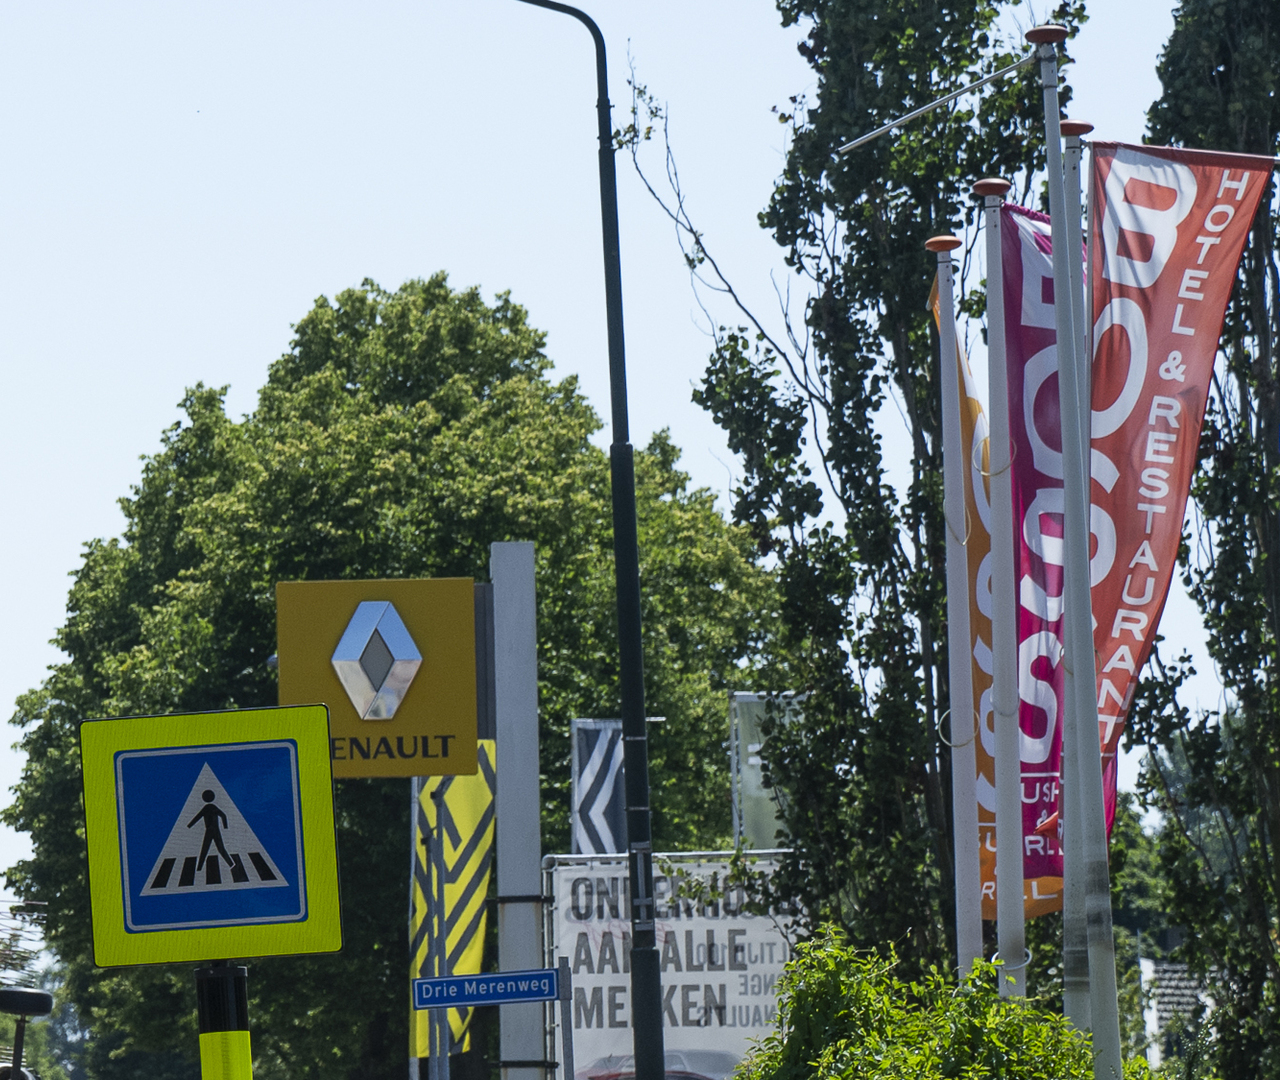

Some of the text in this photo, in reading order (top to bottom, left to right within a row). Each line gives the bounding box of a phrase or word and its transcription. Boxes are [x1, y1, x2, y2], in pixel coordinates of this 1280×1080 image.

[1097, 169, 1251, 745] HOTEL & RESTAURANT
[331, 734, 456, 760] ENAULT
[661, 929, 748, 972] ALLE
[422, 979, 549, 999] Drie Merenweg
[574, 983, 727, 1029] MEKEN
